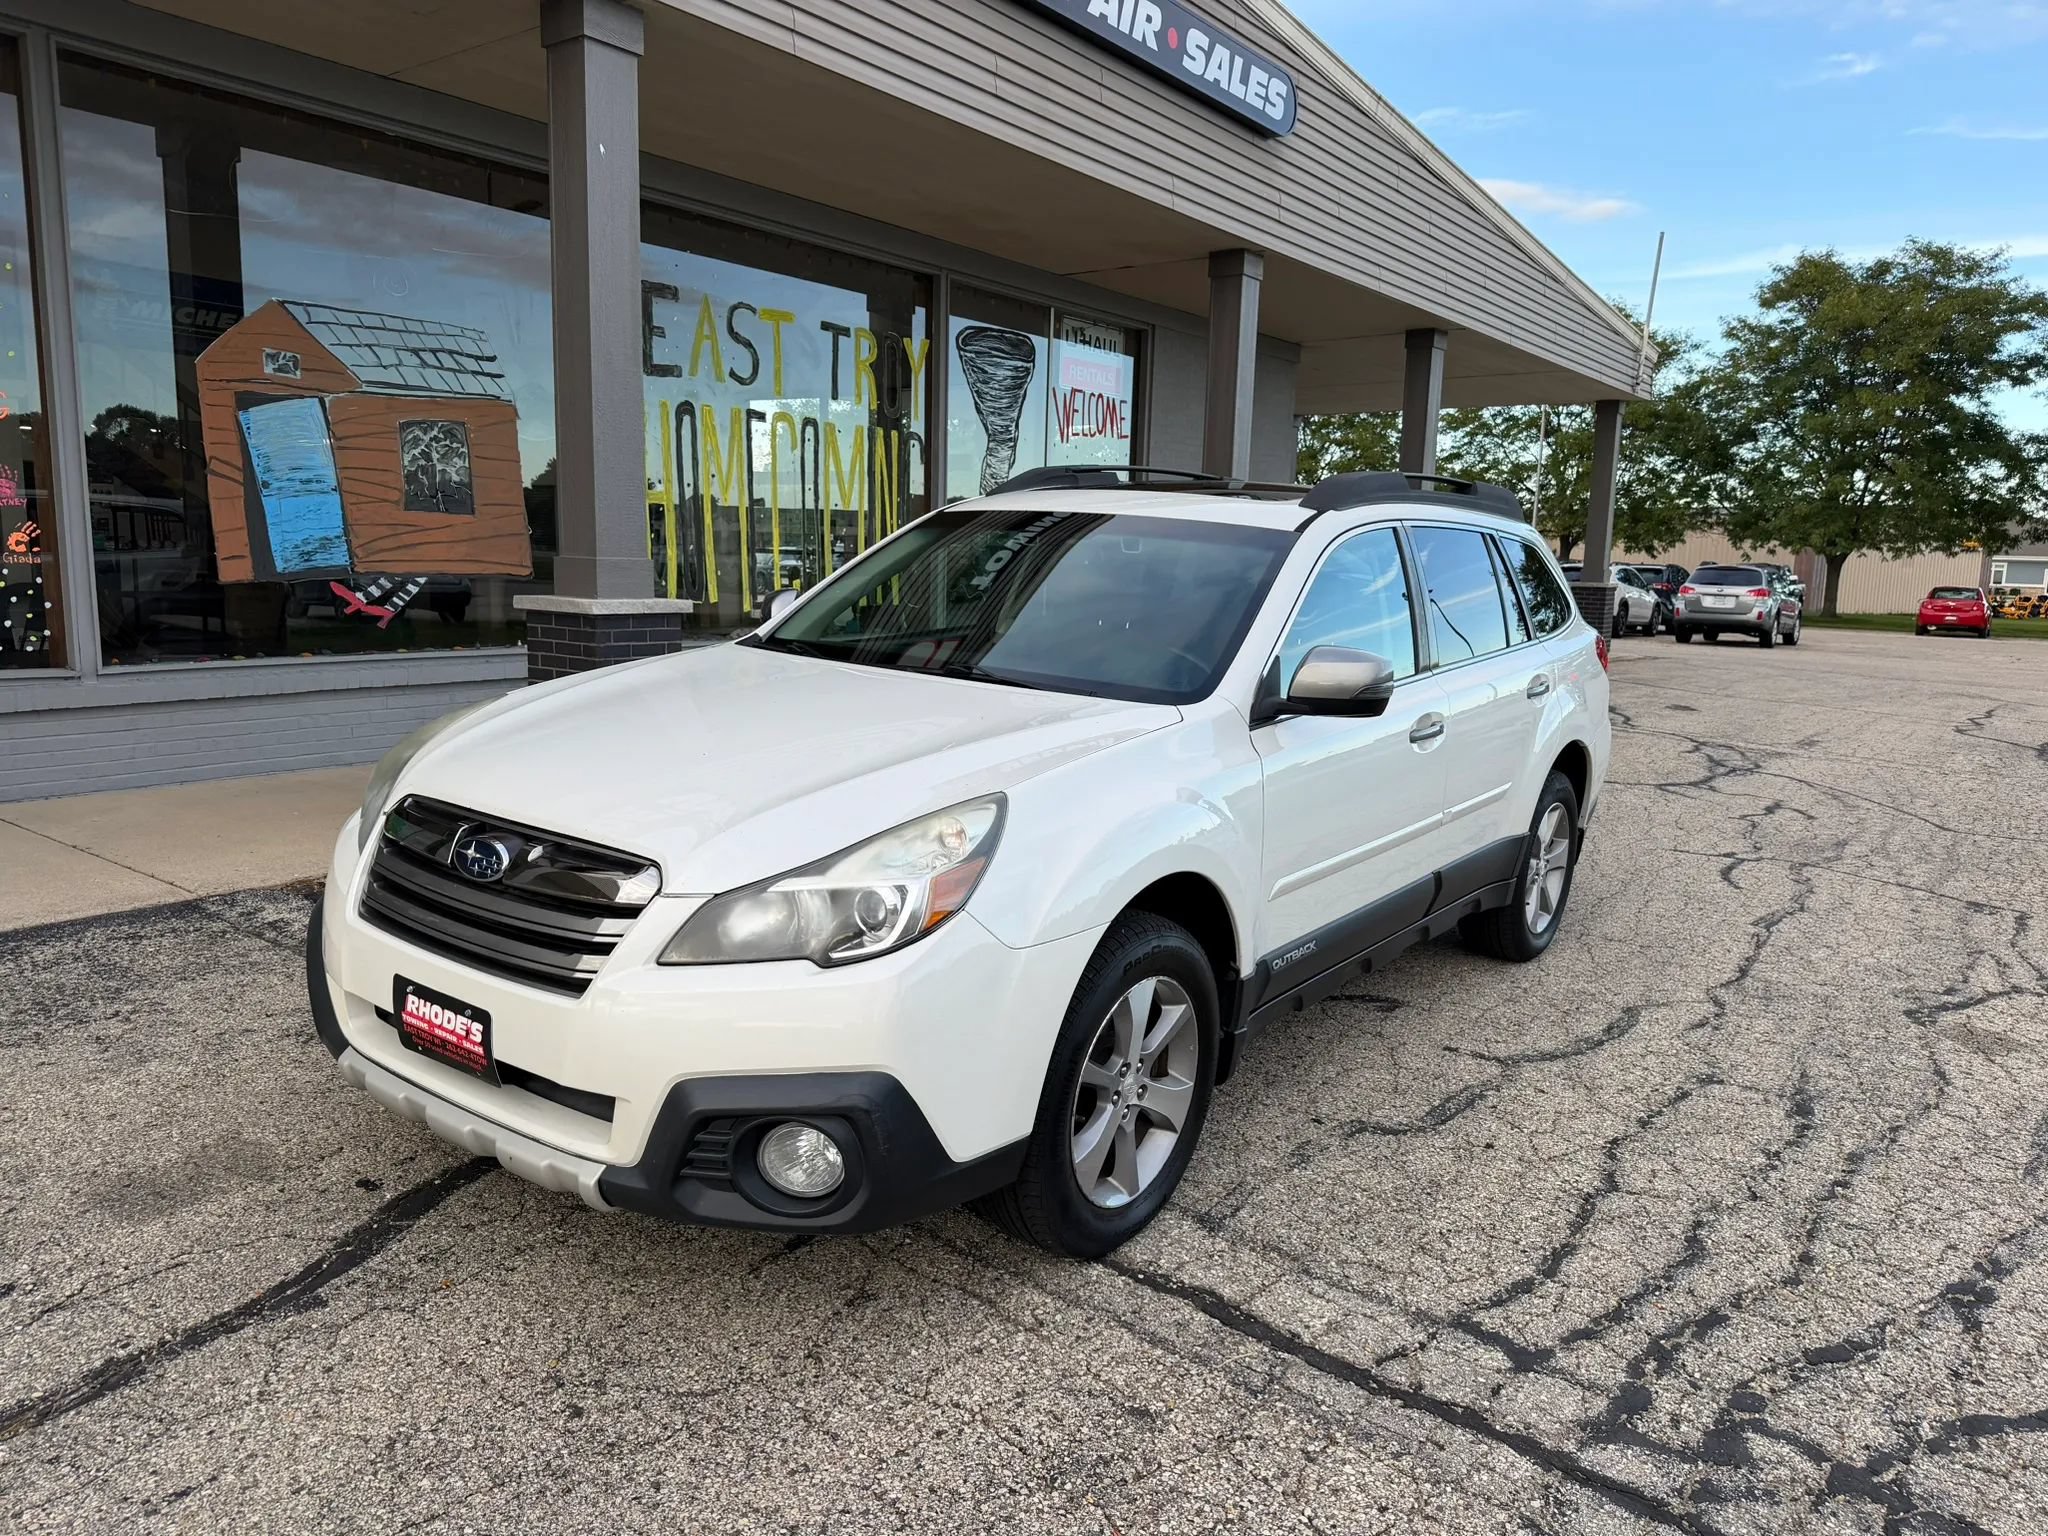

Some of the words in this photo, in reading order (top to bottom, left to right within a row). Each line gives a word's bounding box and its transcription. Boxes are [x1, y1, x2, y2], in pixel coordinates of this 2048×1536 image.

[1182, 28, 1287, 120] SALES
[641, 280, 795, 397] EAST
[820, 320, 929, 421] TROY
[1052, 387, 1129, 443] WELCOME
[3, 551, 42, 564] Giada
[1272, 940, 1317, 970] OUTBACK
[402, 1013, 429, 1030] TOWING
[405, 993, 484, 1043] RHODE'S
